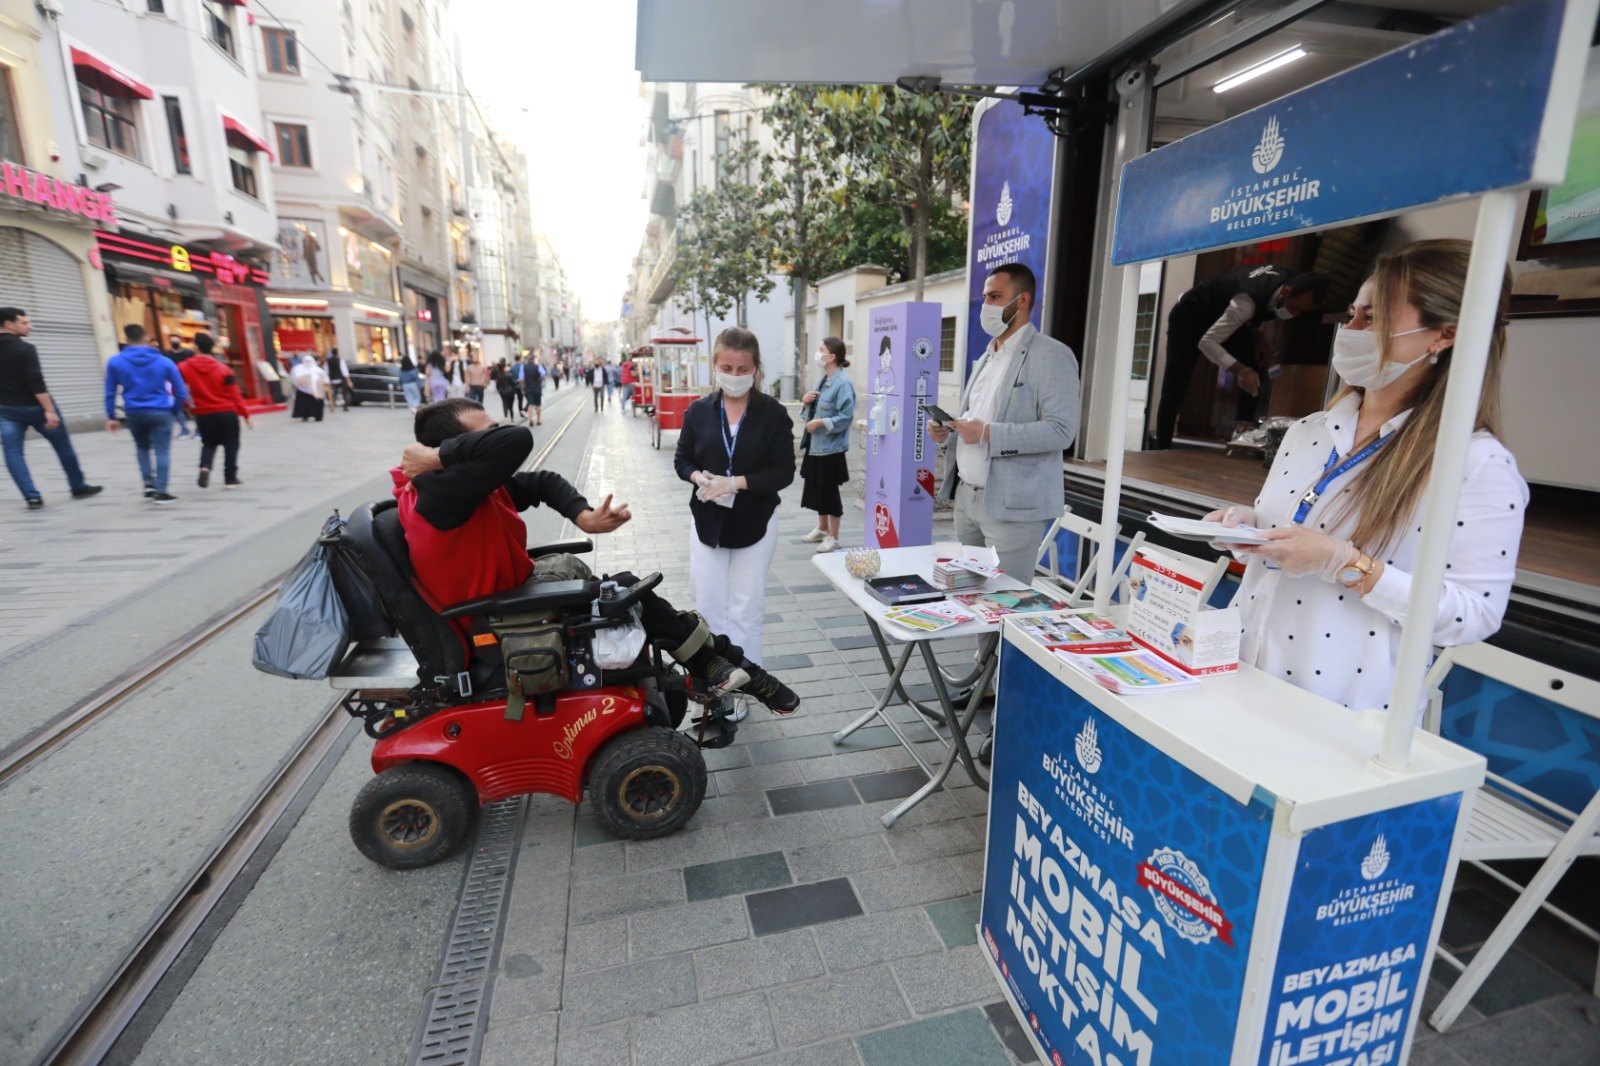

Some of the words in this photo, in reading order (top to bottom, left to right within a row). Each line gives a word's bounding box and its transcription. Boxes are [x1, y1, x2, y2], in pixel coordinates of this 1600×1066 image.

[0, 162, 119, 224] HANGE
[1210, 177, 1320, 223] BÜYÜKŞEHİR
[1231, 171, 1299, 198] İSTANBUL
[987, 226, 1020, 243] İSTANBUL
[1226, 206, 1295, 231] BELEDİYESİ
[977, 231, 1030, 263] BÜYÜKŞEHİR
[985, 252, 1019, 270] BELEDİYESİ
[553, 708, 597, 759] Optimus
[601, 697, 616, 715] 2
[1043, 752, 1134, 851] BÜYÜKŞEHİR
[1058, 752, 1115, 811] İSTANBUL
[1055, 785, 1111, 845] BELEDİYESİ
[1017, 780, 1166, 959] BEYAZMASA
[1157, 854, 1176, 867] HER
[1176, 856, 1210, 898] YERDE
[1339, 878, 1399, 899] İSTANBUL
[1014, 813, 1158, 1026] MOBİL
[1143, 867, 1223, 928] BÜYÜKŞEHİR
[1156, 895, 1176, 922] HER
[1176, 919, 1209, 936] YERDE
[1316, 883, 1415, 921] BÜYÜKŞEHİR
[1333, 905, 1395, 927] BELEDİYESİ
[1006, 904, 1124, 1066] NOKTA
[1010, 861, 1154, 1066] İLETİŞİM
[1282, 943, 1416, 993] BEYAZMASA
[1274, 968, 1408, 1037] MOBİL
[1269, 1009, 1402, 1066] İLETİŞİM
